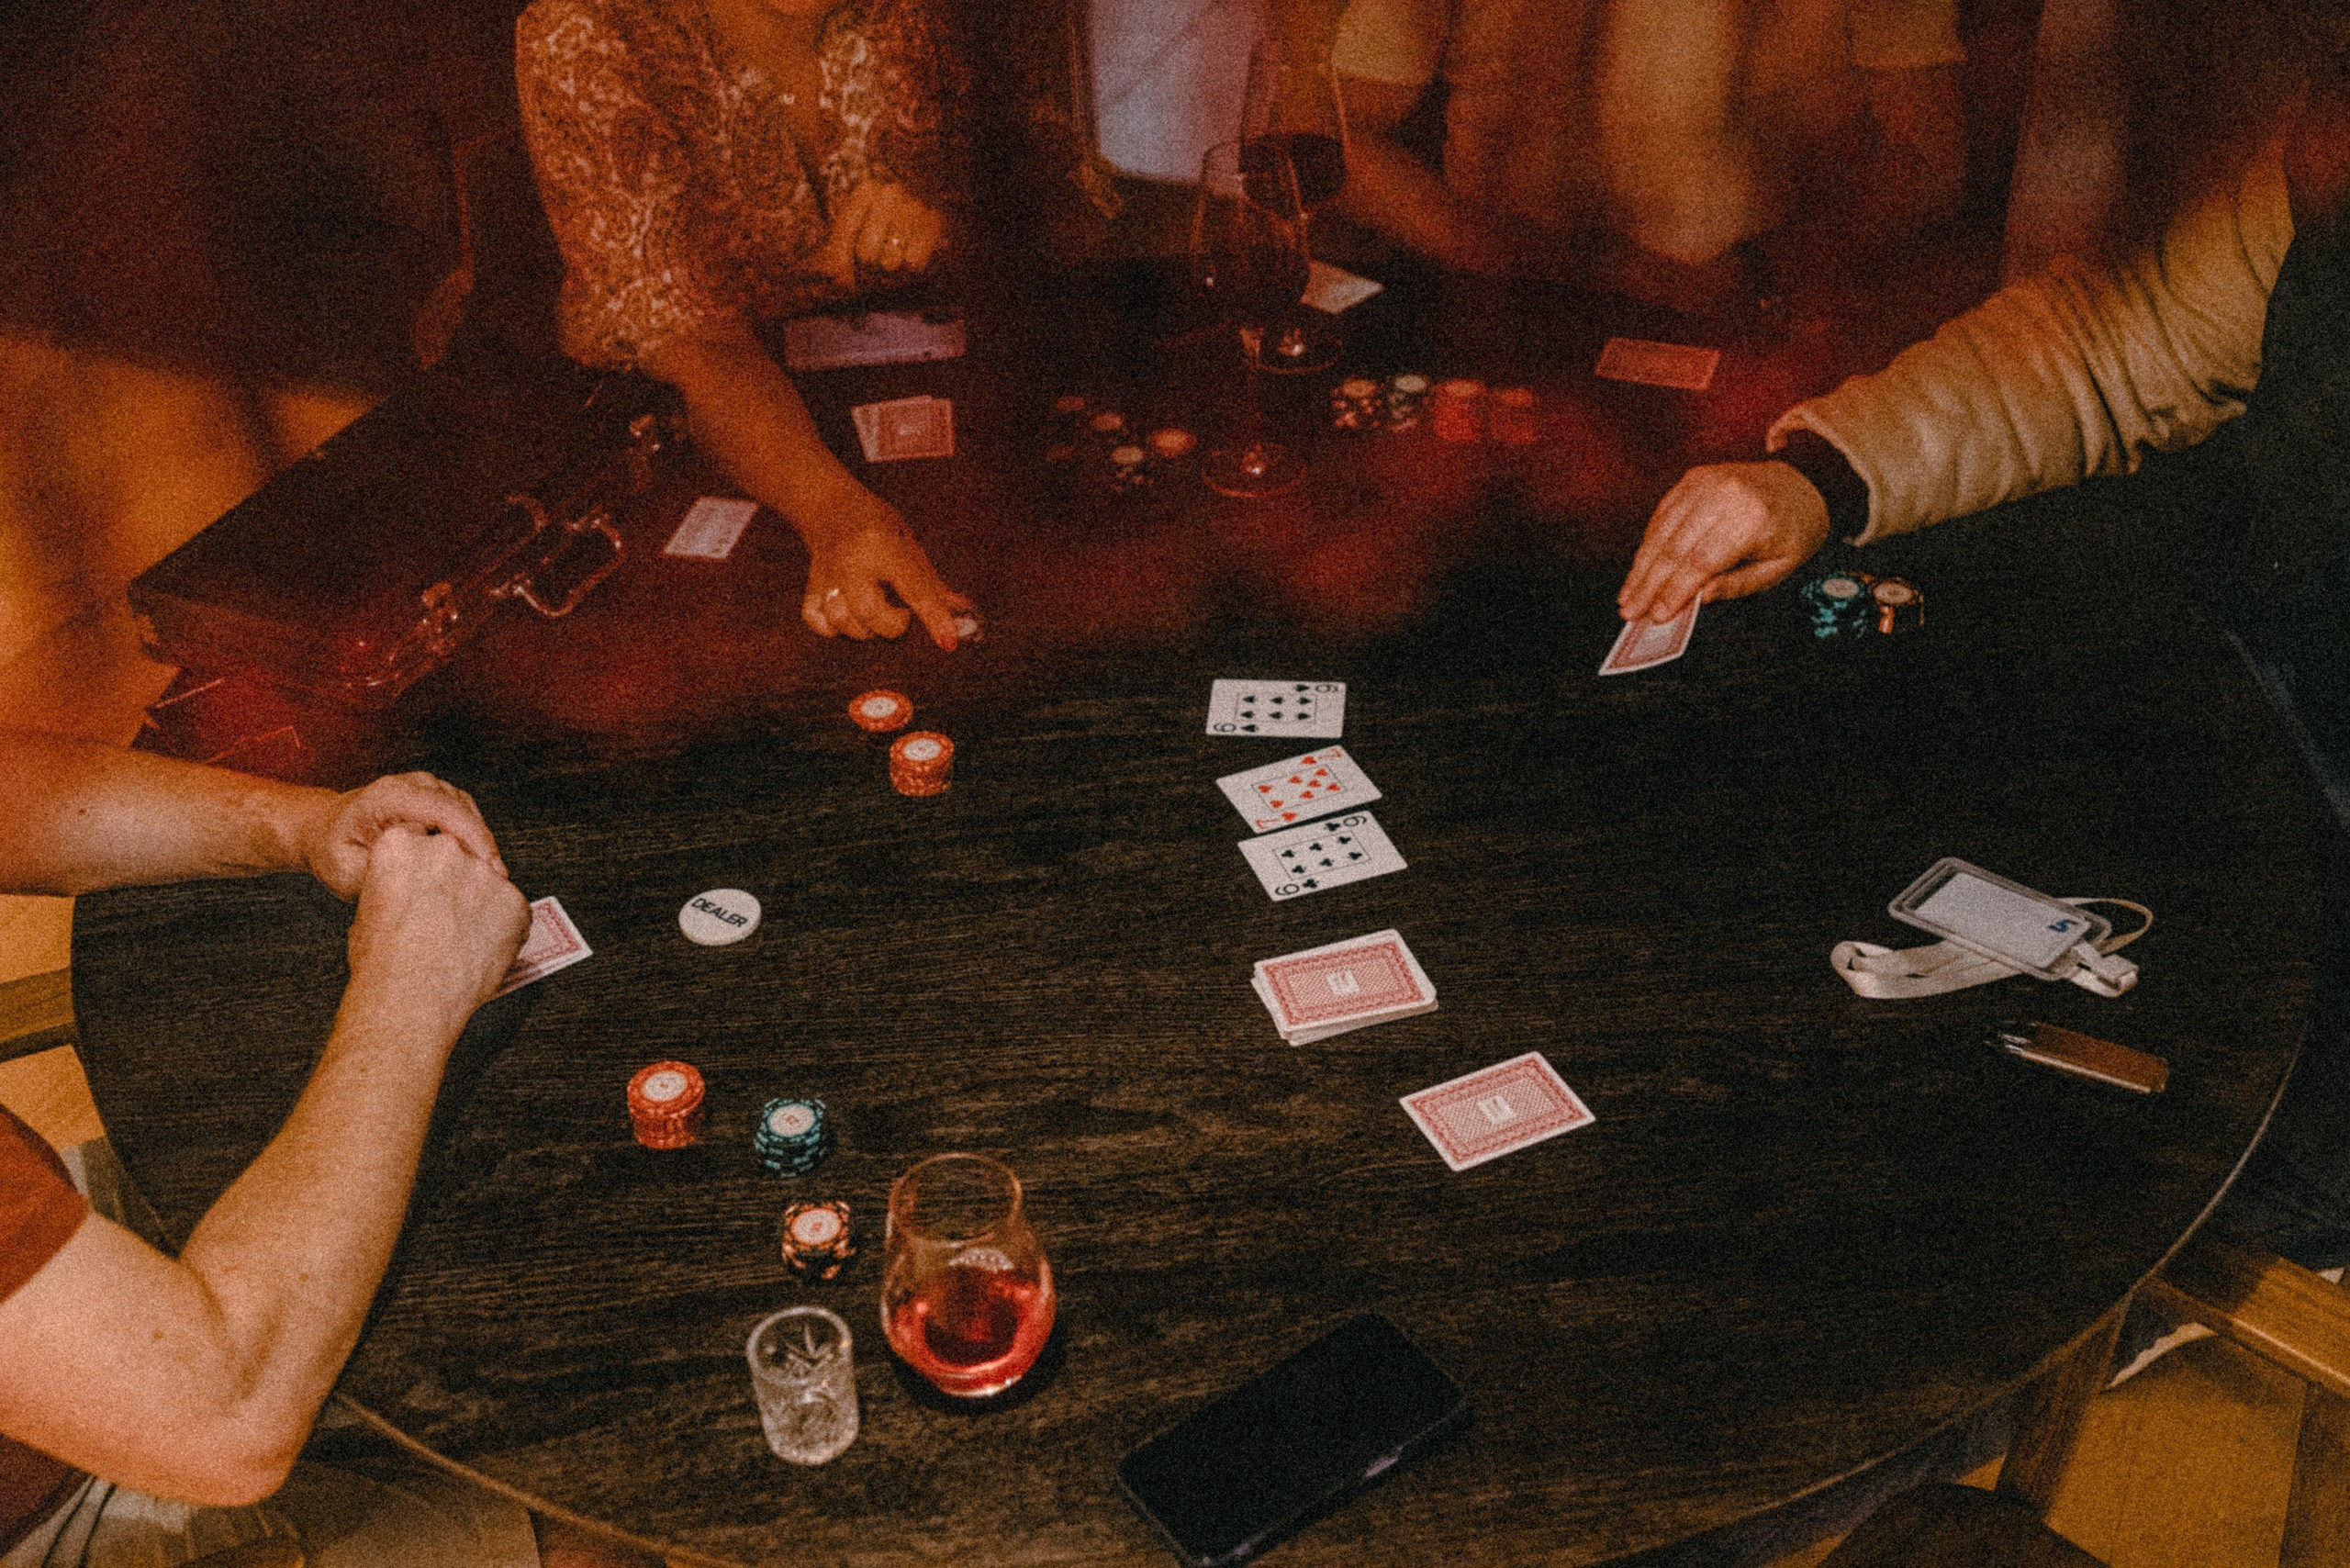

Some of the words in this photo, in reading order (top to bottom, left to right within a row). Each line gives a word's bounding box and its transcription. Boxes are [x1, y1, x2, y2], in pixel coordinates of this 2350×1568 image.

[1214, 722, 1237, 733] 6
[1318, 748, 1342, 759] 7
[1255, 818, 1280, 830] 7
[1343, 815, 1367, 827] 6
[1275, 883, 1300, 896] 6
[691, 898, 747, 927] DEALER
